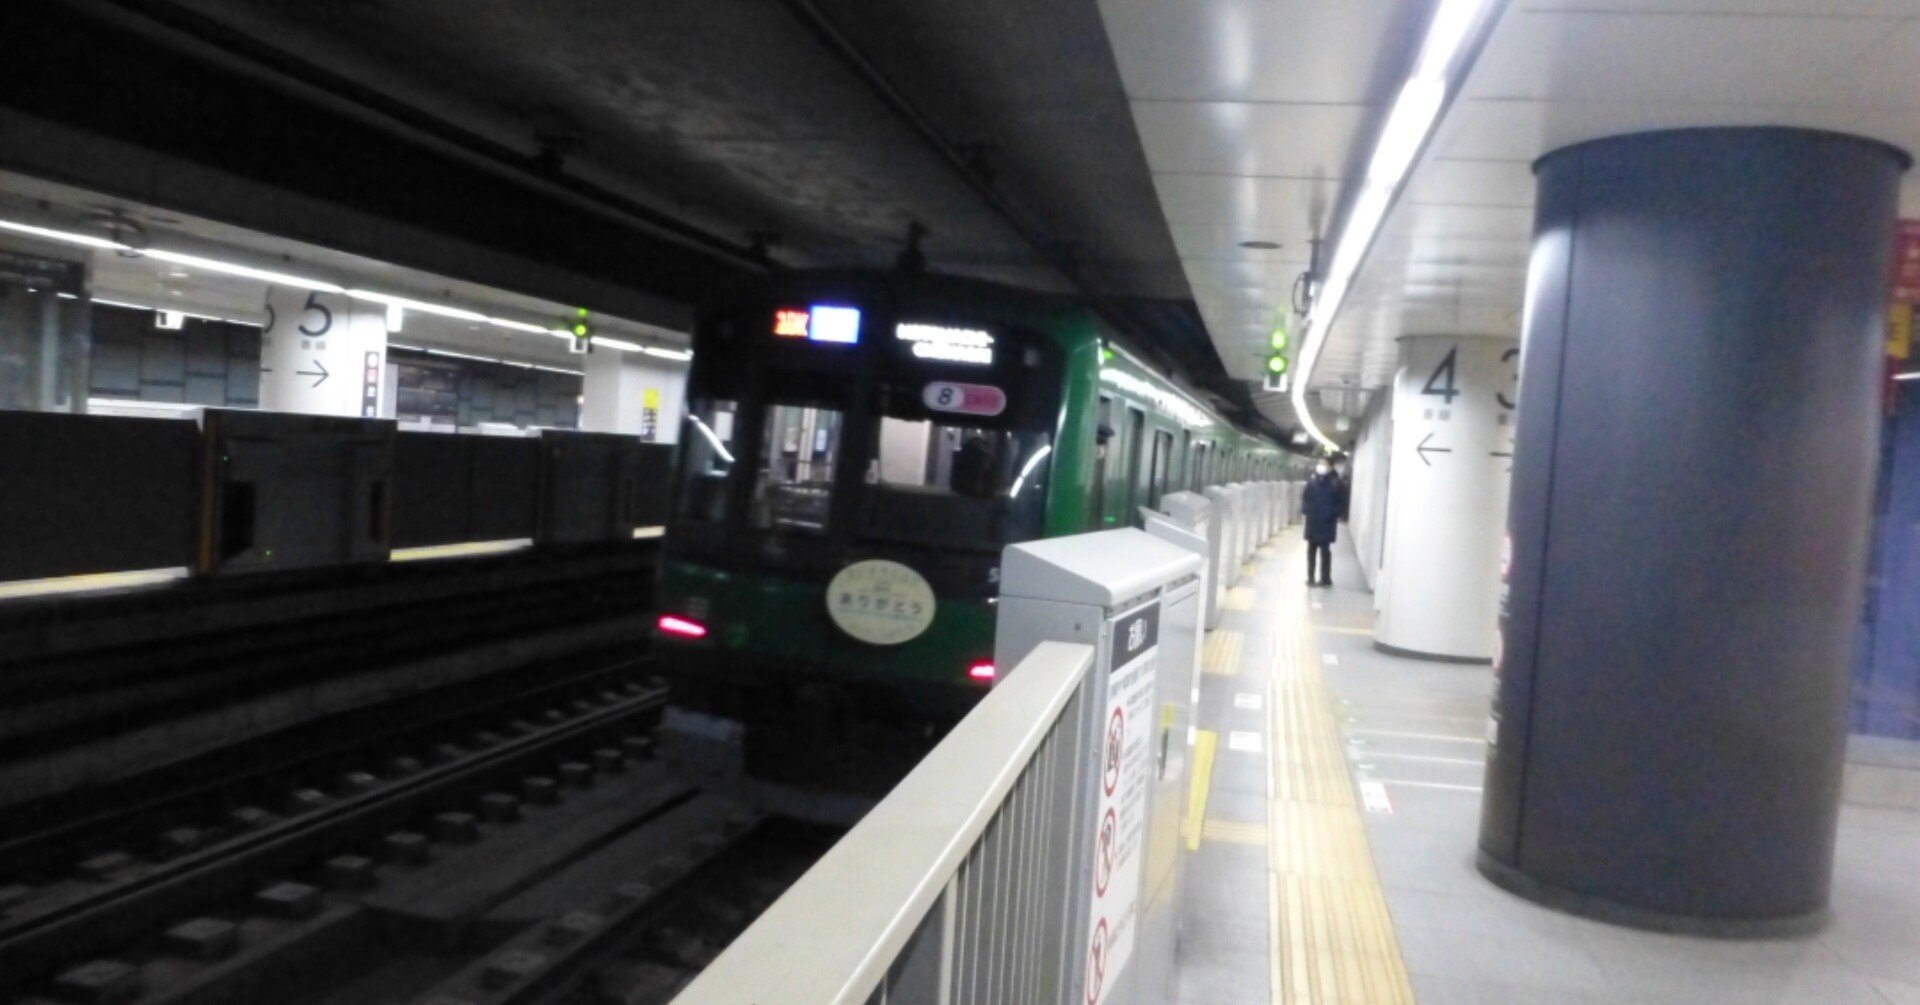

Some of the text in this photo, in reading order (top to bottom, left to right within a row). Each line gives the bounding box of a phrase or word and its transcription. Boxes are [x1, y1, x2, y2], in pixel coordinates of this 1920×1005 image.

[298, 290, 332, 337] 5
[938, 387, 954, 405] 8
[1421, 346, 1460, 404] 4
